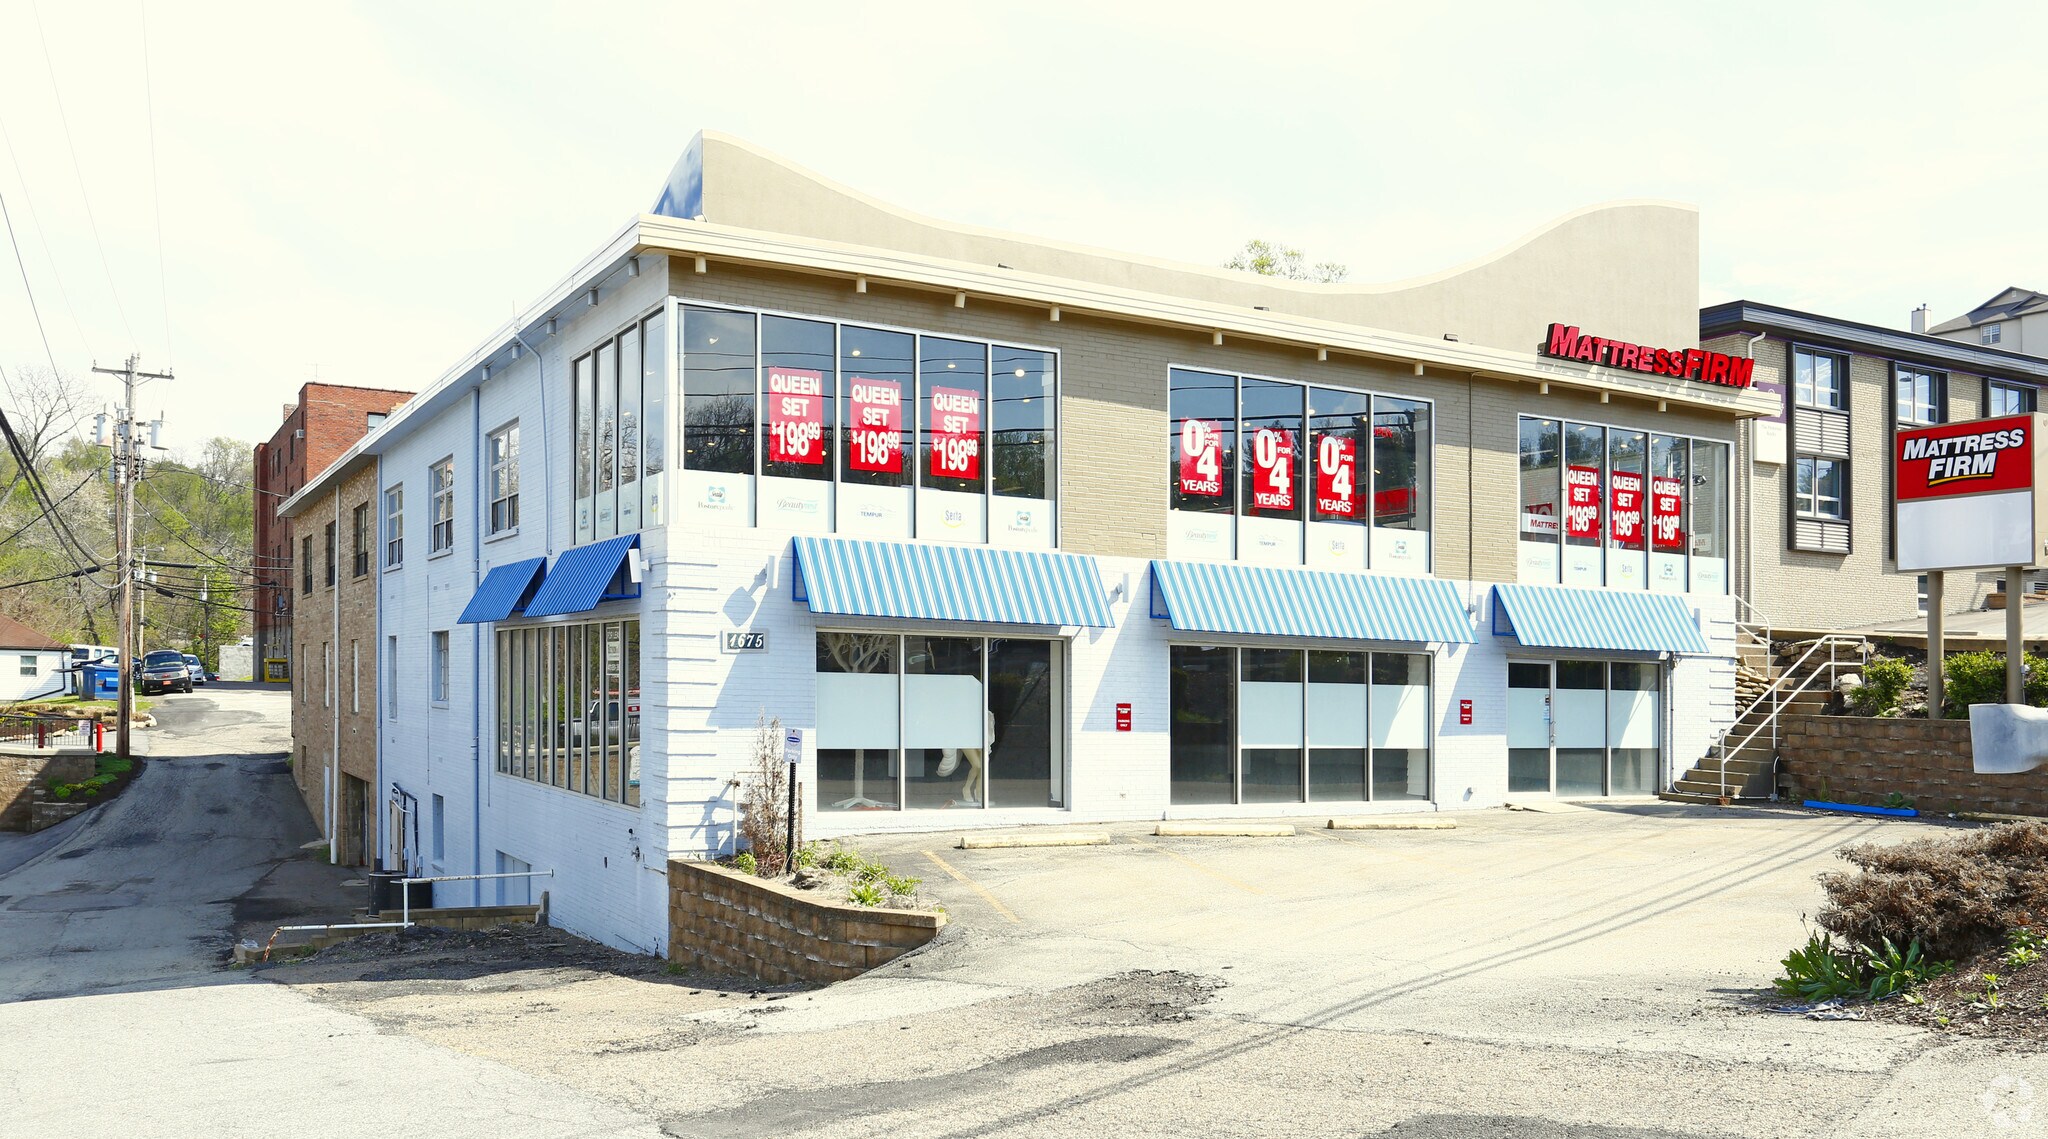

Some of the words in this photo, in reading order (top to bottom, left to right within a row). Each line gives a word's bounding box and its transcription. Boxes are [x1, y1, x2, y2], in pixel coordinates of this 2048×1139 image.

[771, 374, 820, 396] QUEEN
[852, 384, 899, 406] QUEEN
[782, 397, 809, 417] SET
[933, 393, 978, 415] QUEEN
[862, 406, 889, 427] SET
[943, 414, 969, 434] SET
[1373, 426, 1393, 438] PEN
[1902, 428, 2025, 461] MATTRESS
[1197, 446, 1218, 481] 4
[1340, 454, 1353, 462] FOR
[1928, 452, 1997, 480] FIRM
[1269, 457, 1290, 494] 4
[1332, 464, 1352, 500] 4
[1568, 469, 1597, 485] QUEEN
[1612, 475, 1640, 491] QUEEN
[1573, 488, 1590, 502] SET
[1653, 481, 1680, 496] QUEEN
[1617, 494, 1634, 507] SET
[1660, 498, 1676, 512] SET
[945, 510, 962, 521] Serta
[729, 633, 763, 649] 1675
